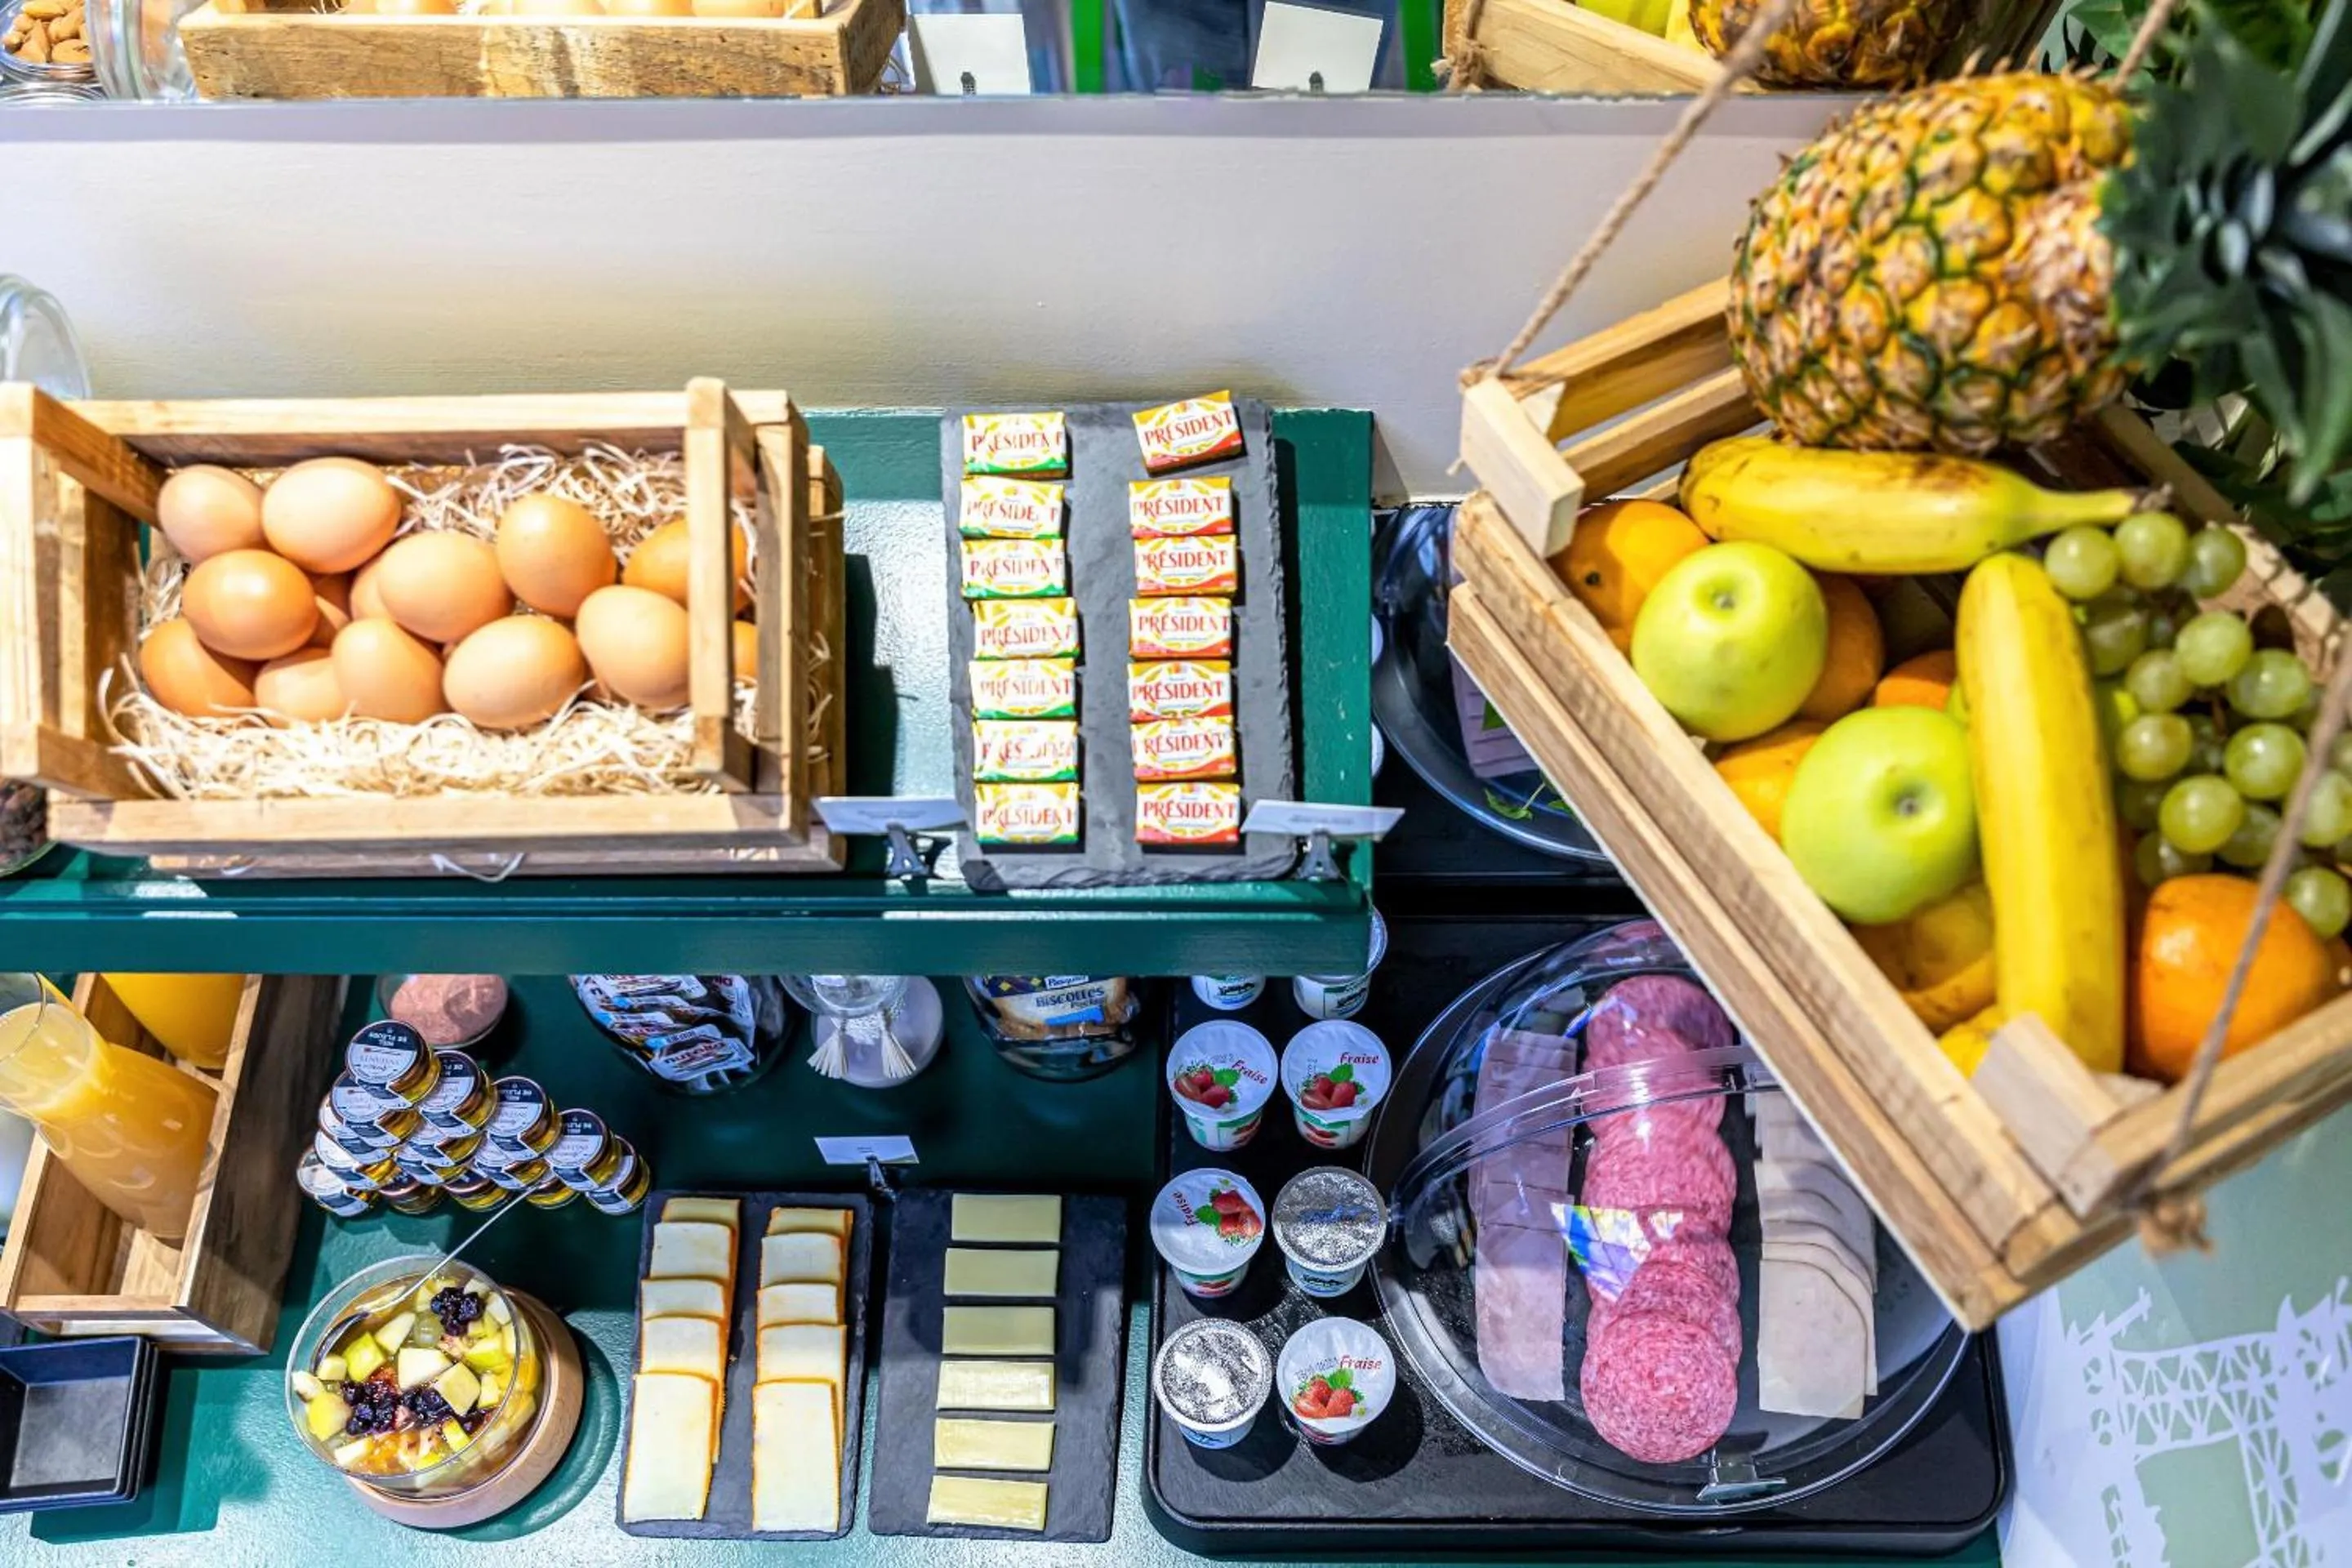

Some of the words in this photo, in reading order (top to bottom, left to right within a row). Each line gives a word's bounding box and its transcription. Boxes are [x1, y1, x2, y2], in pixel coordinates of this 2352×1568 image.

[1144, 409, 1232, 447] PRÉSIDENT
[967, 500, 1058, 522] PRÉSIDET
[1133, 681, 1223, 704] PRÉSIDENT
[1143, 800, 1236, 822] PRÉSIDENT
[1340, 1051, 1379, 1065] Fraise
[1232, 1060, 1267, 1085] Fraise
[1172, 1192, 1200, 1226] Fraise
[1339, 1355, 1382, 1370] Fraise
